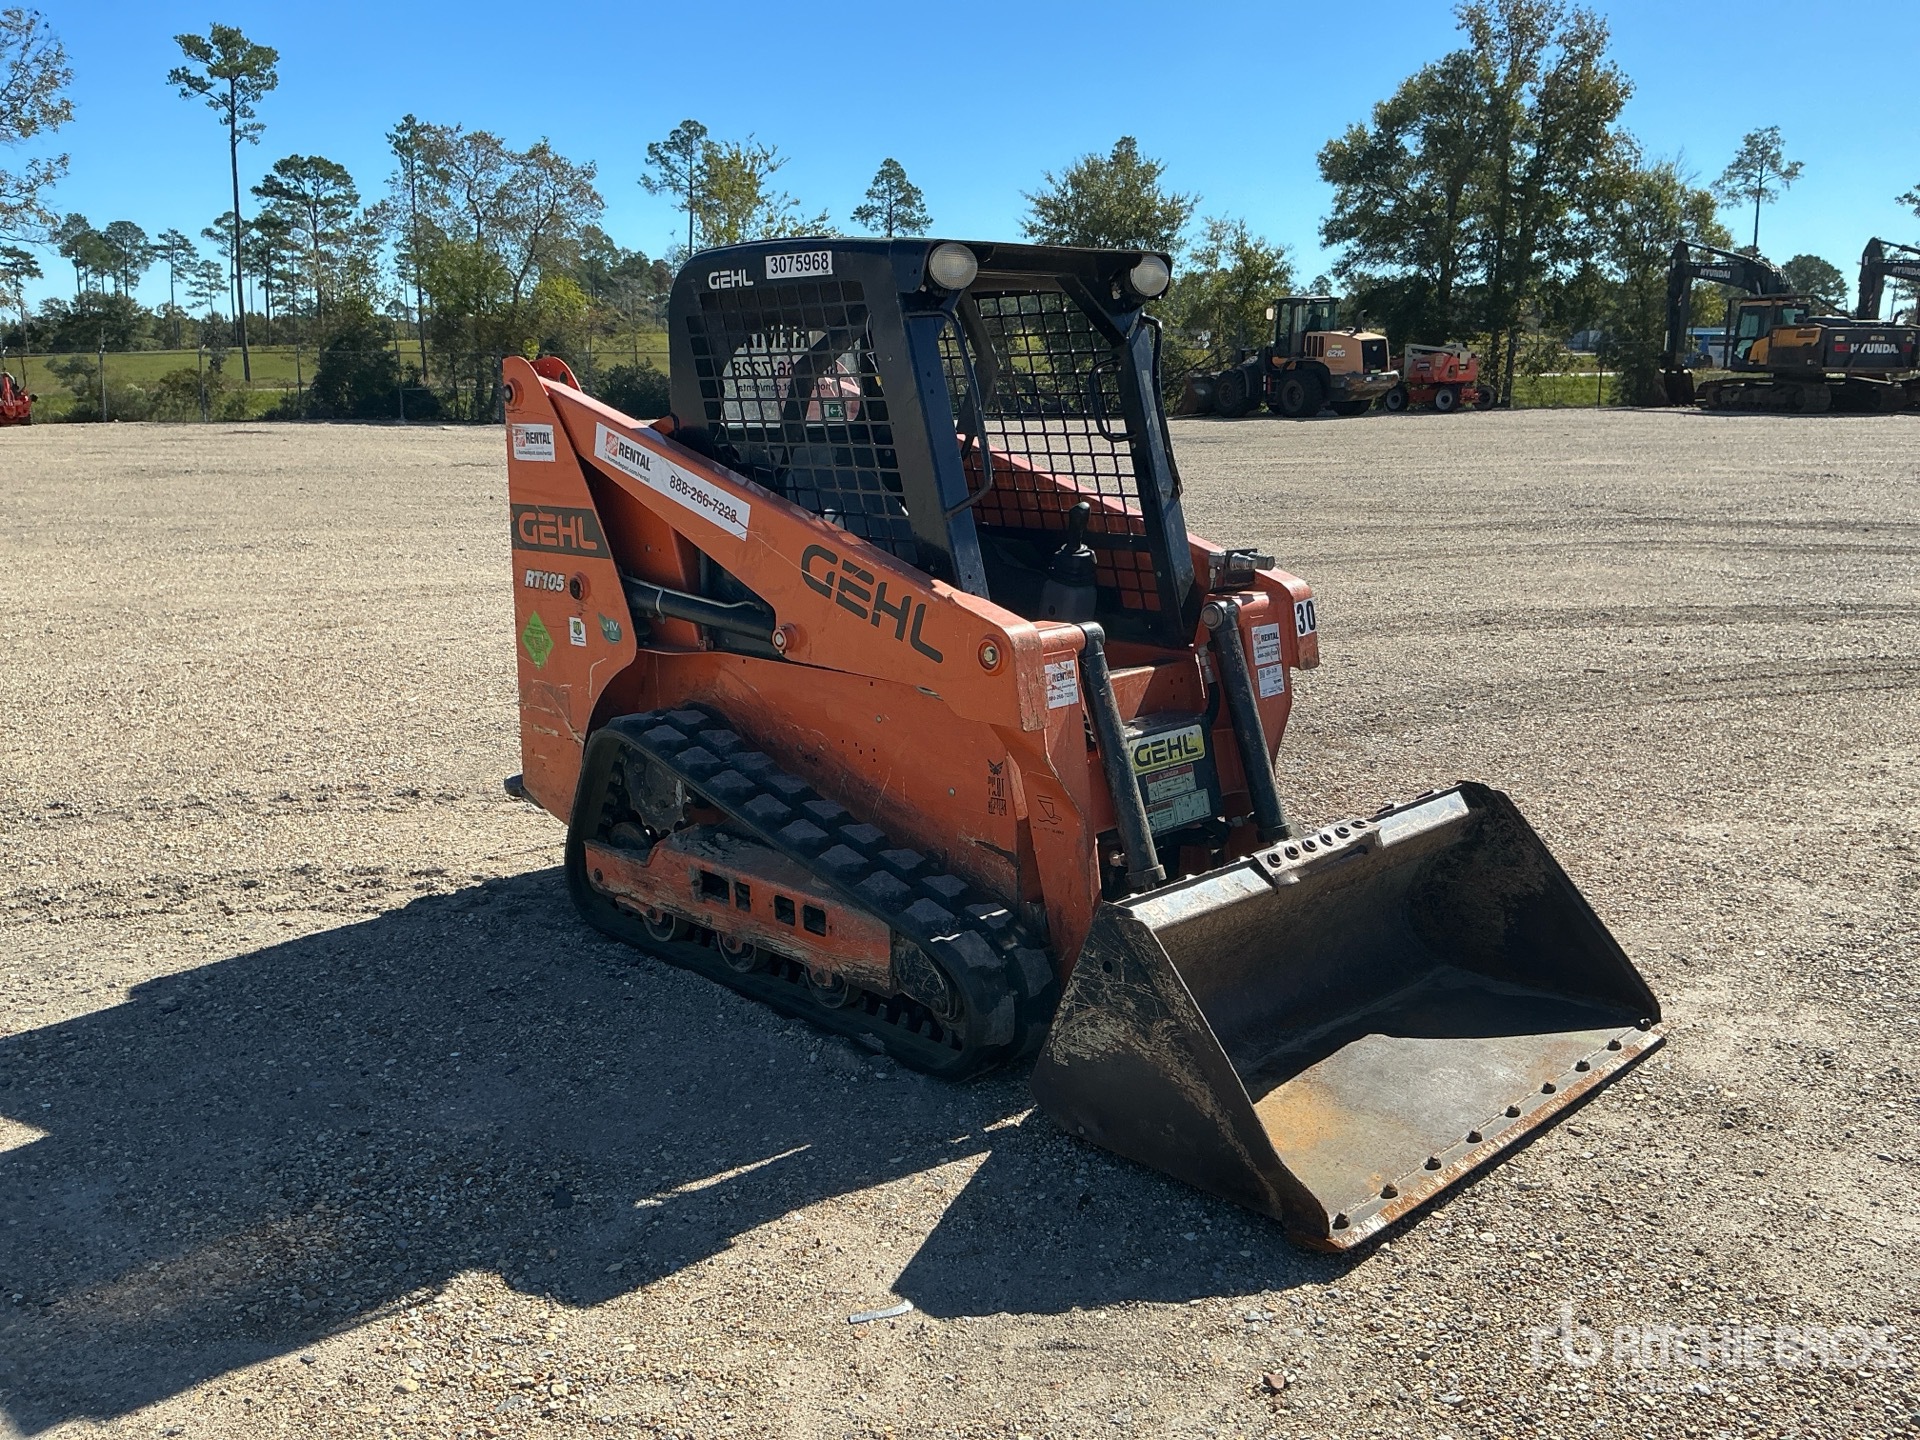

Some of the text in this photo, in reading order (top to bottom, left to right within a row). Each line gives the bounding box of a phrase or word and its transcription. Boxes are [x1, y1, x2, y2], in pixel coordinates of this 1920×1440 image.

[771, 252, 829, 274] 3075968
[708, 269, 754, 290] GEHL
[1850, 343, 1900, 354] HYUNDA
[525, 431, 552, 445] RENTAL
[619, 442, 651, 472] RENTAL
[669, 475, 737, 524] 888-266-7228
[518, 511, 598, 550] GEHL
[524, 569, 566, 592] RT105
[801, 544, 944, 664] GEHL
[1296, 600, 1316, 634] 30
[1261, 632, 1279, 643] RENTAL
[1134, 733, 1198, 767] GEHL
